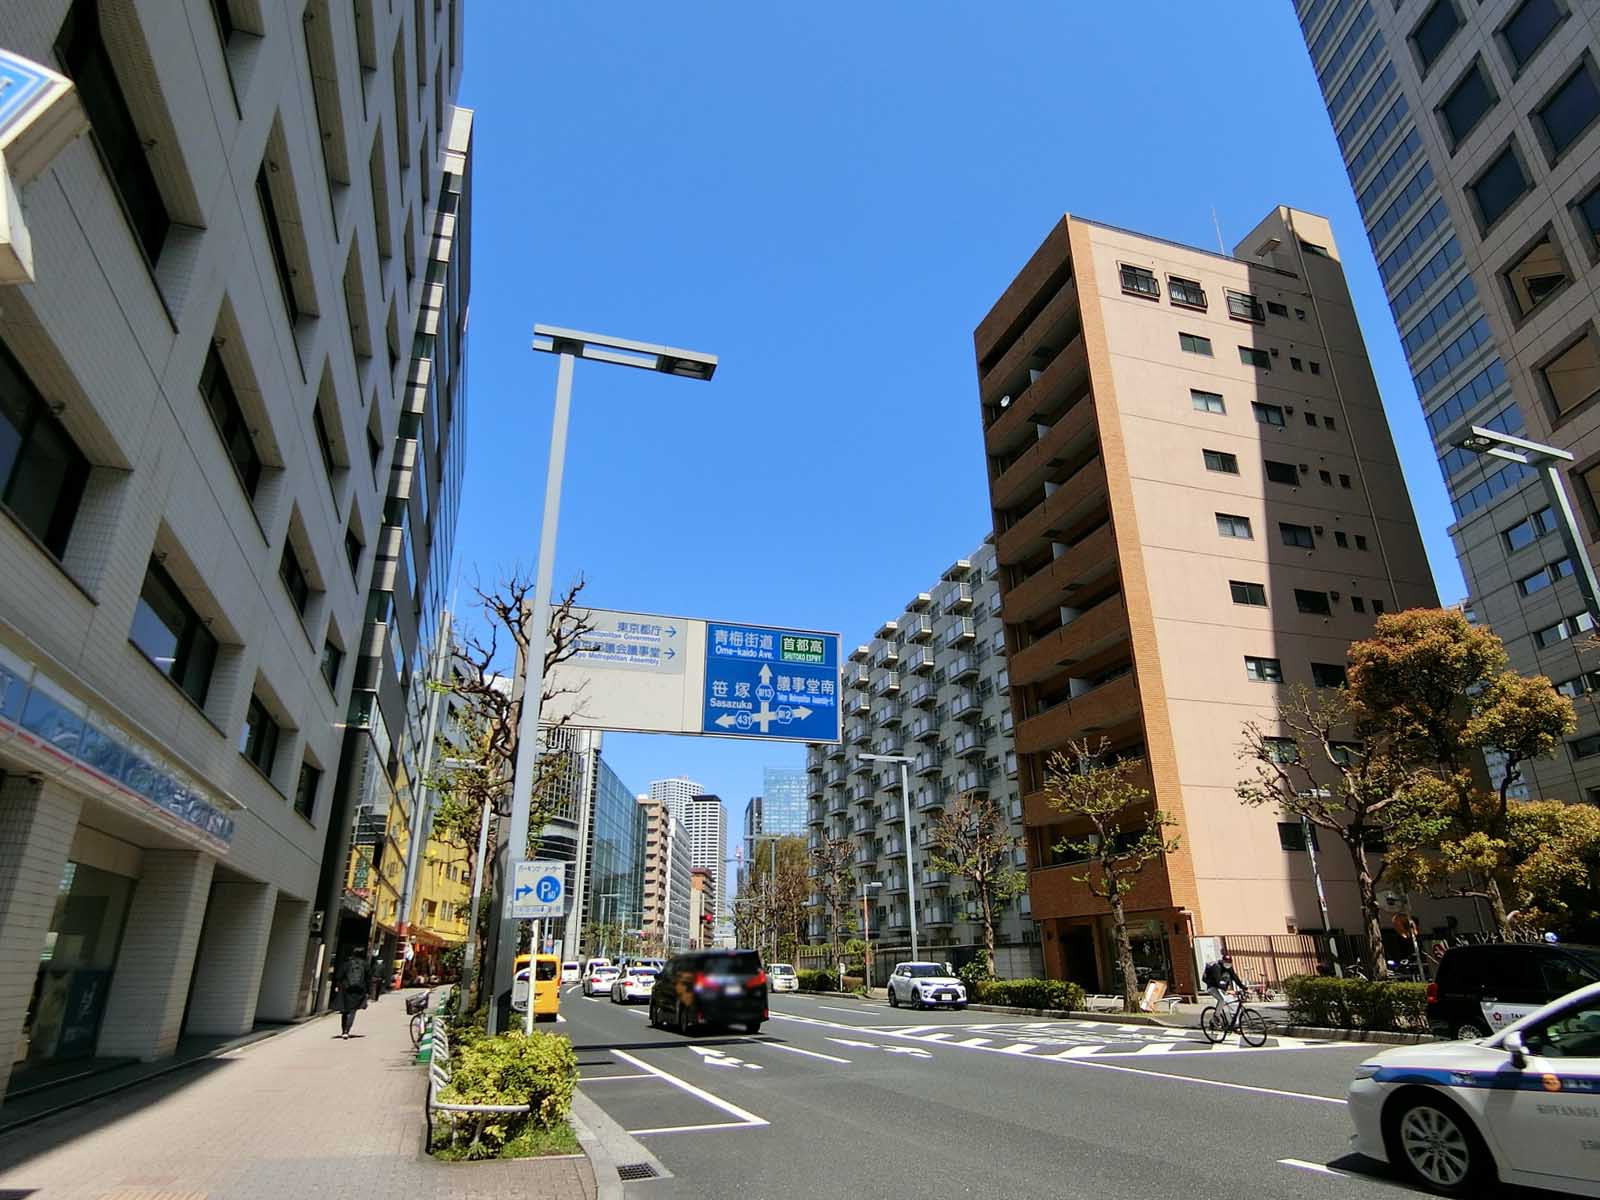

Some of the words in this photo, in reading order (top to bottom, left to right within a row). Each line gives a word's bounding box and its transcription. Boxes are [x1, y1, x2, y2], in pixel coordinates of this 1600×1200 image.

[714, 629, 774, 650] 青梅街道
[783, 637, 823, 653] 首都高
[776, 675, 835, 695] 議事堂南
[709, 697, 753, 710] Sasazuka
